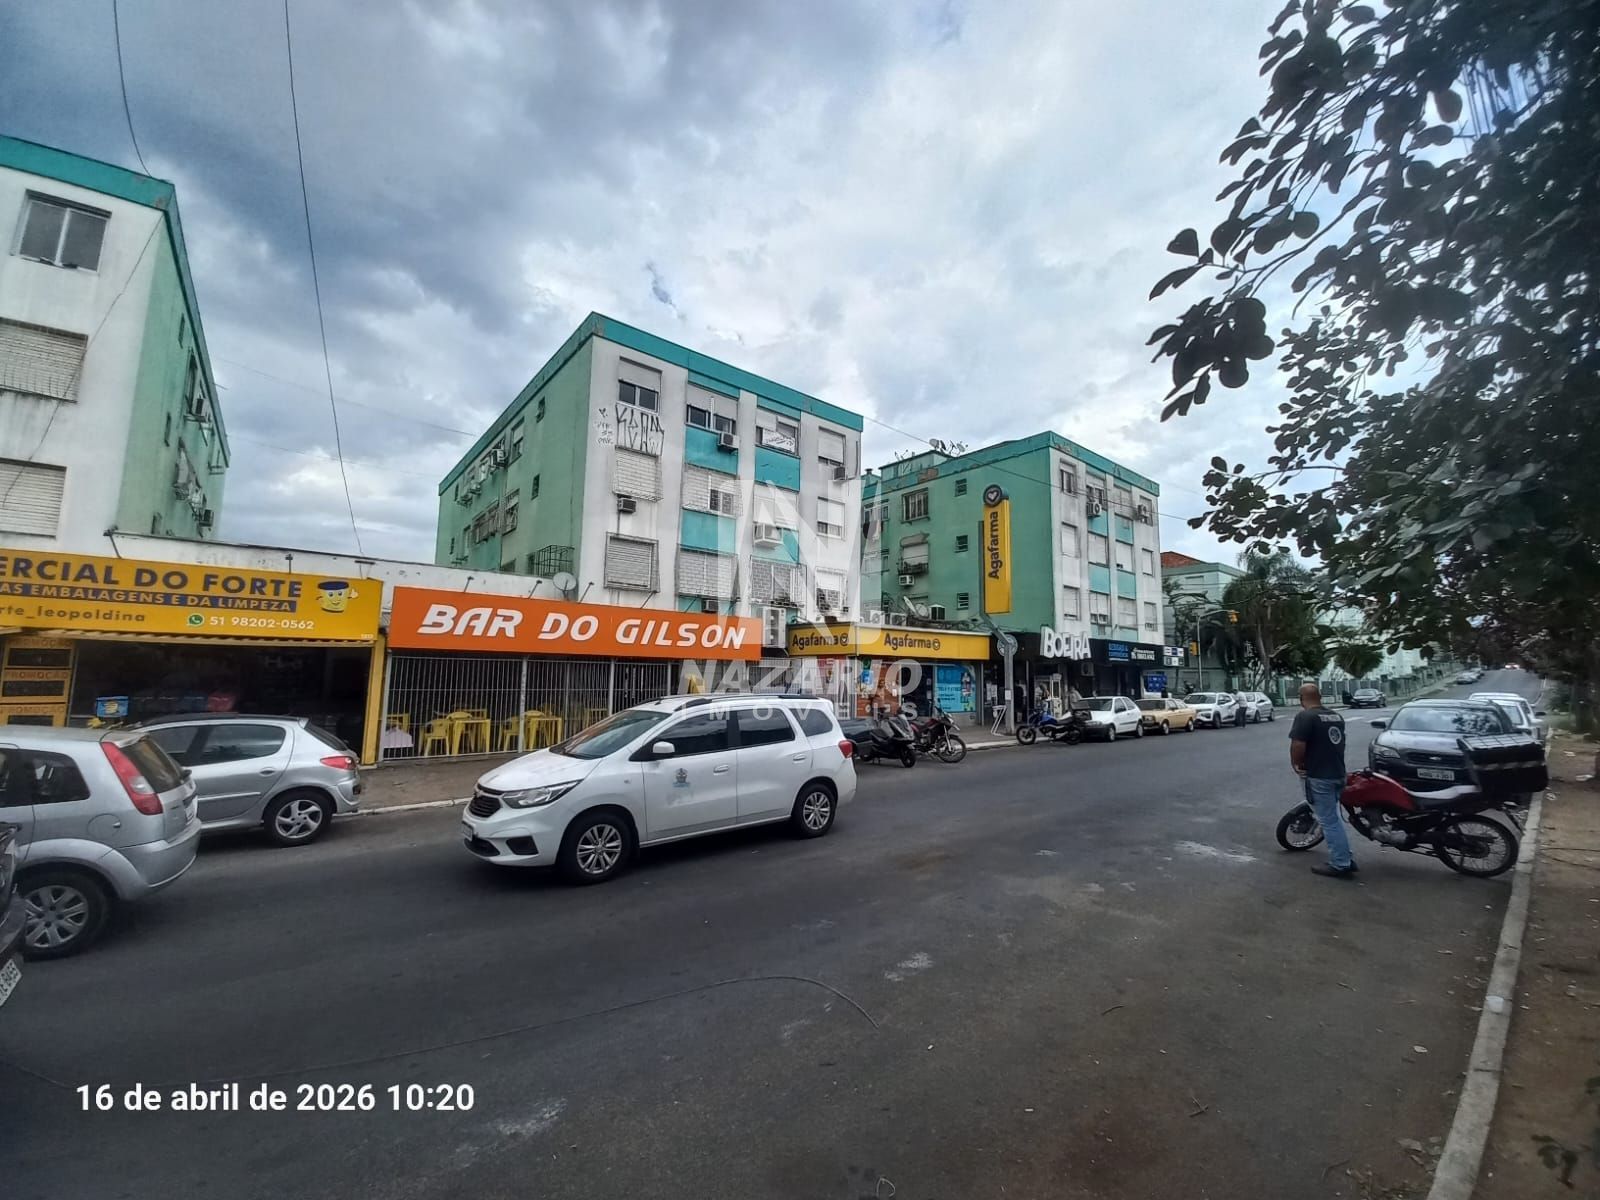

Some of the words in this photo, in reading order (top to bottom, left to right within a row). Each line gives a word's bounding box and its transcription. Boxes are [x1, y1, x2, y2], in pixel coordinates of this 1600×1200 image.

[988, 511, 1003, 579] Agafarma
[0, 583, 23, 594] AS
[30, 585, 165, 604] EMBALAGENS
[171, 595, 181, 605] E
[187, 596, 212, 607] DA
[218, 598, 291, 612] LIMPEZA
[134, 568, 188, 590] DO
[203, 574, 302, 598] FORTE
[210, 616, 225, 626] 51
[231, 616, 314, 629] 98202-0562
[417, 604, 524, 638] BAR
[538, 613, 598, 641] DO
[615, 618, 746, 650] GILSON
[884, 633, 931, 650] Agafarma
[1040, 625, 1091, 660] BOEIRA
